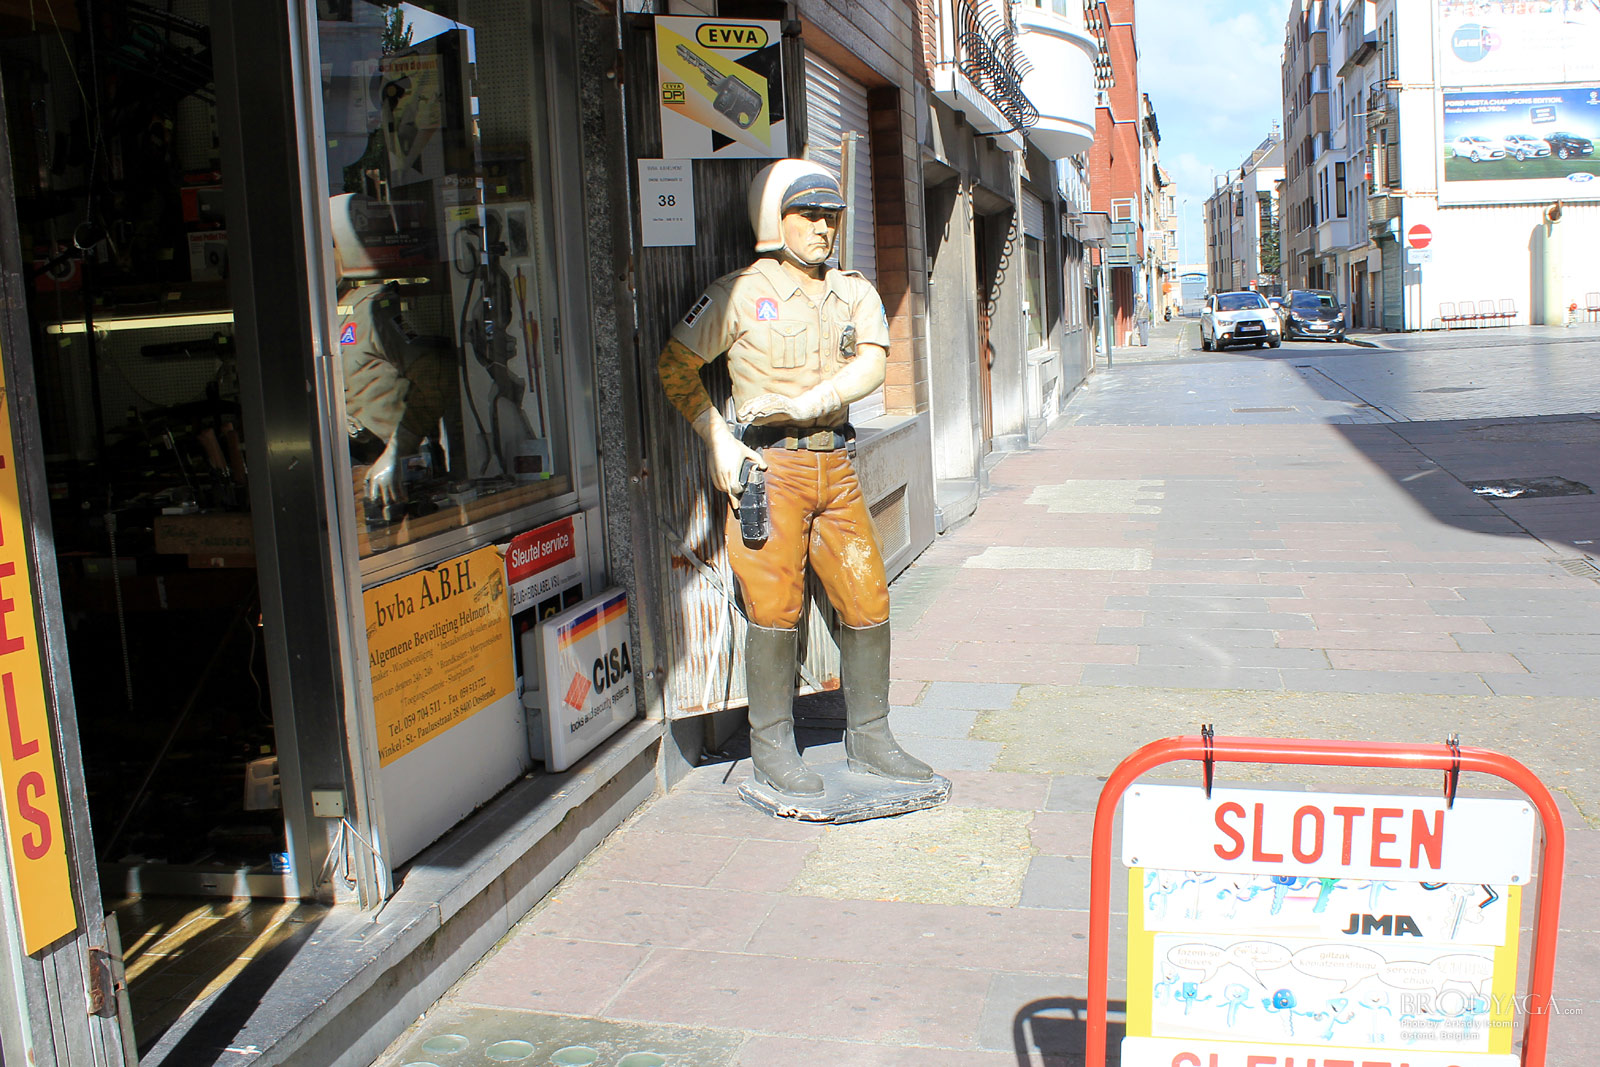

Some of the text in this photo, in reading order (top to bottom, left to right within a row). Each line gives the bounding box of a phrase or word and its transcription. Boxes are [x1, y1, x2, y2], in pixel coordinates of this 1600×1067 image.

[708, 29, 758, 44] EVVA
[658, 194, 676, 207] 38
[511, 533, 569, 568] Sleutel service
[375, 559, 477, 627] bvba A.B.H.
[369, 639, 413, 668] Algemene
[413, 619, 460, 648] Beveiliging
[592, 641, 632, 695] CISA
[388, 720, 404, 737] Tel.
[404, 713, 416, 730] 059
[416, 706, 429, 722] 704
[429, 699, 441, 716] 511
[448, 693, 458, 705] Fax
[417, 711, 453, 740] Paulusstraat
[472, 687, 496, 708] Oostende
[570, 716, 585, 734] locks
[593, 697, 612, 717] security
[611, 684, 630, 705] systems
[1213, 801, 1445, 870] SLOTEN
[1341, 913, 1424, 938] JMA
